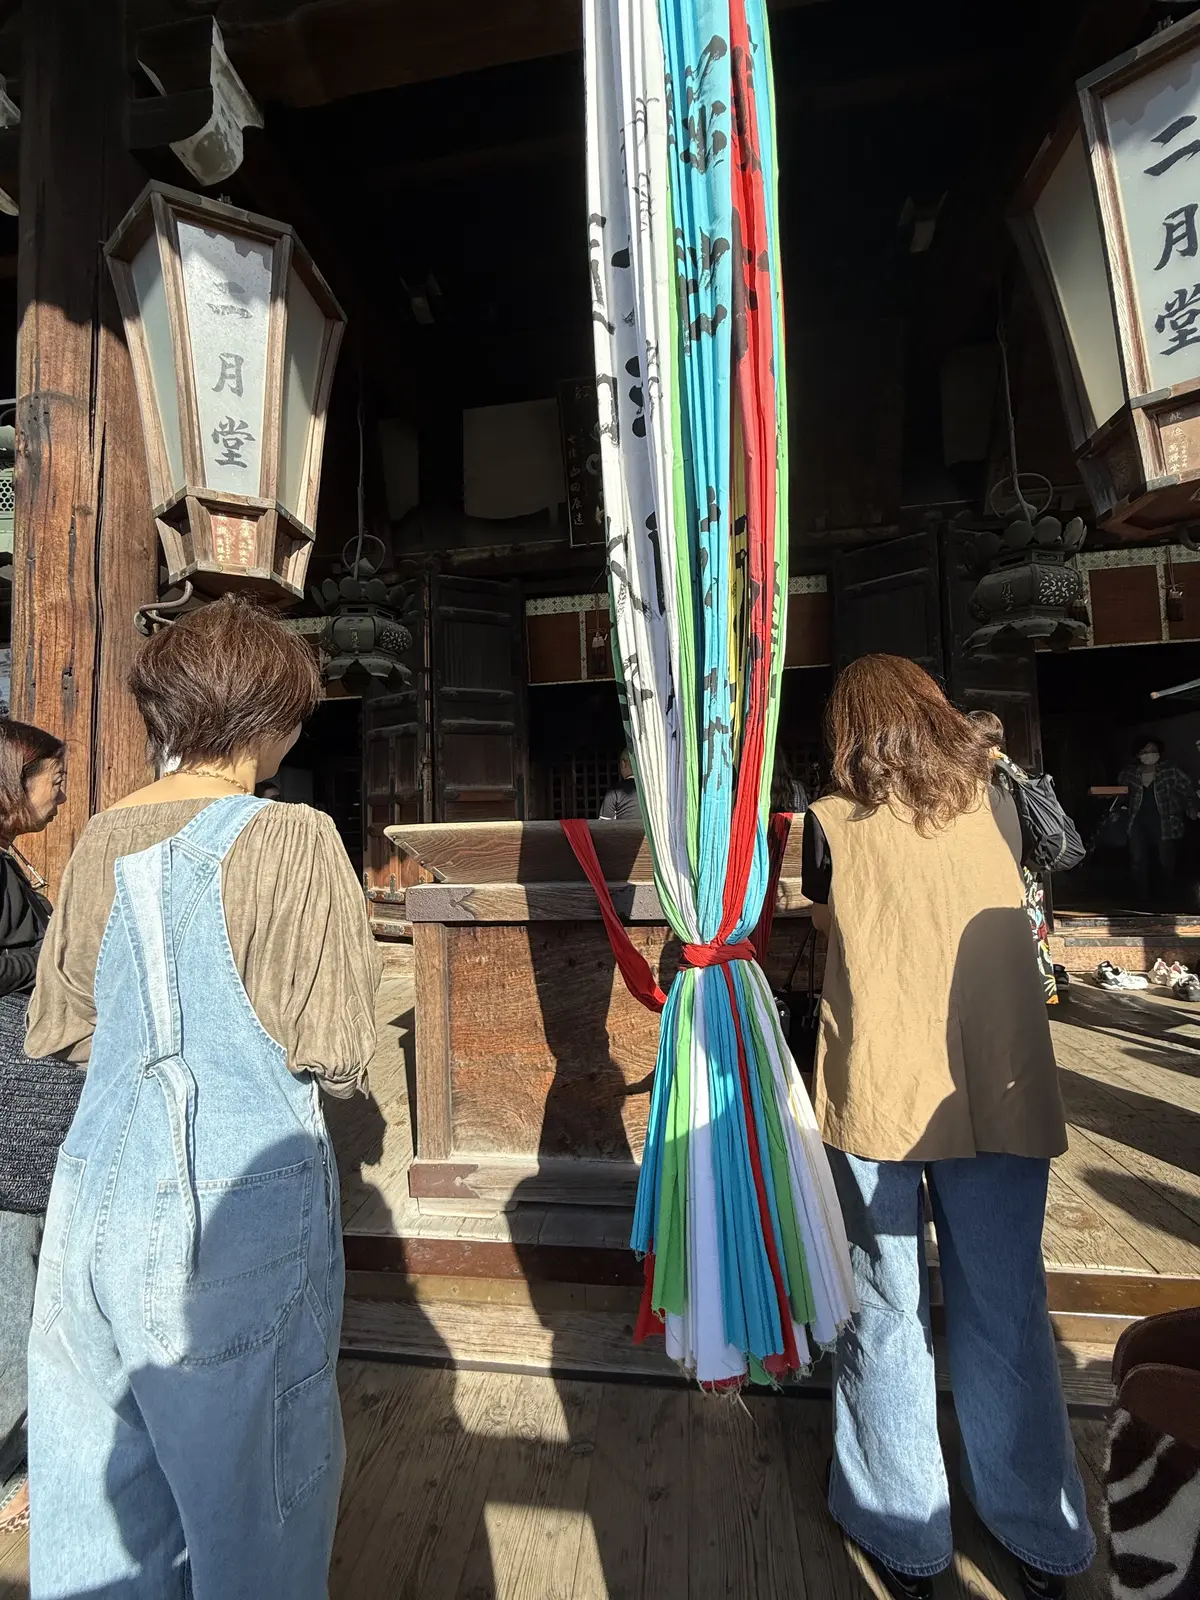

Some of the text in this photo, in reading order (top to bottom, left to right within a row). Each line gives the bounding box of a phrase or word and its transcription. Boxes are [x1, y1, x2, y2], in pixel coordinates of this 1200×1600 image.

[1143, 115, 1200, 356] 二月堂
[206, 281, 256, 469] 二月堂
